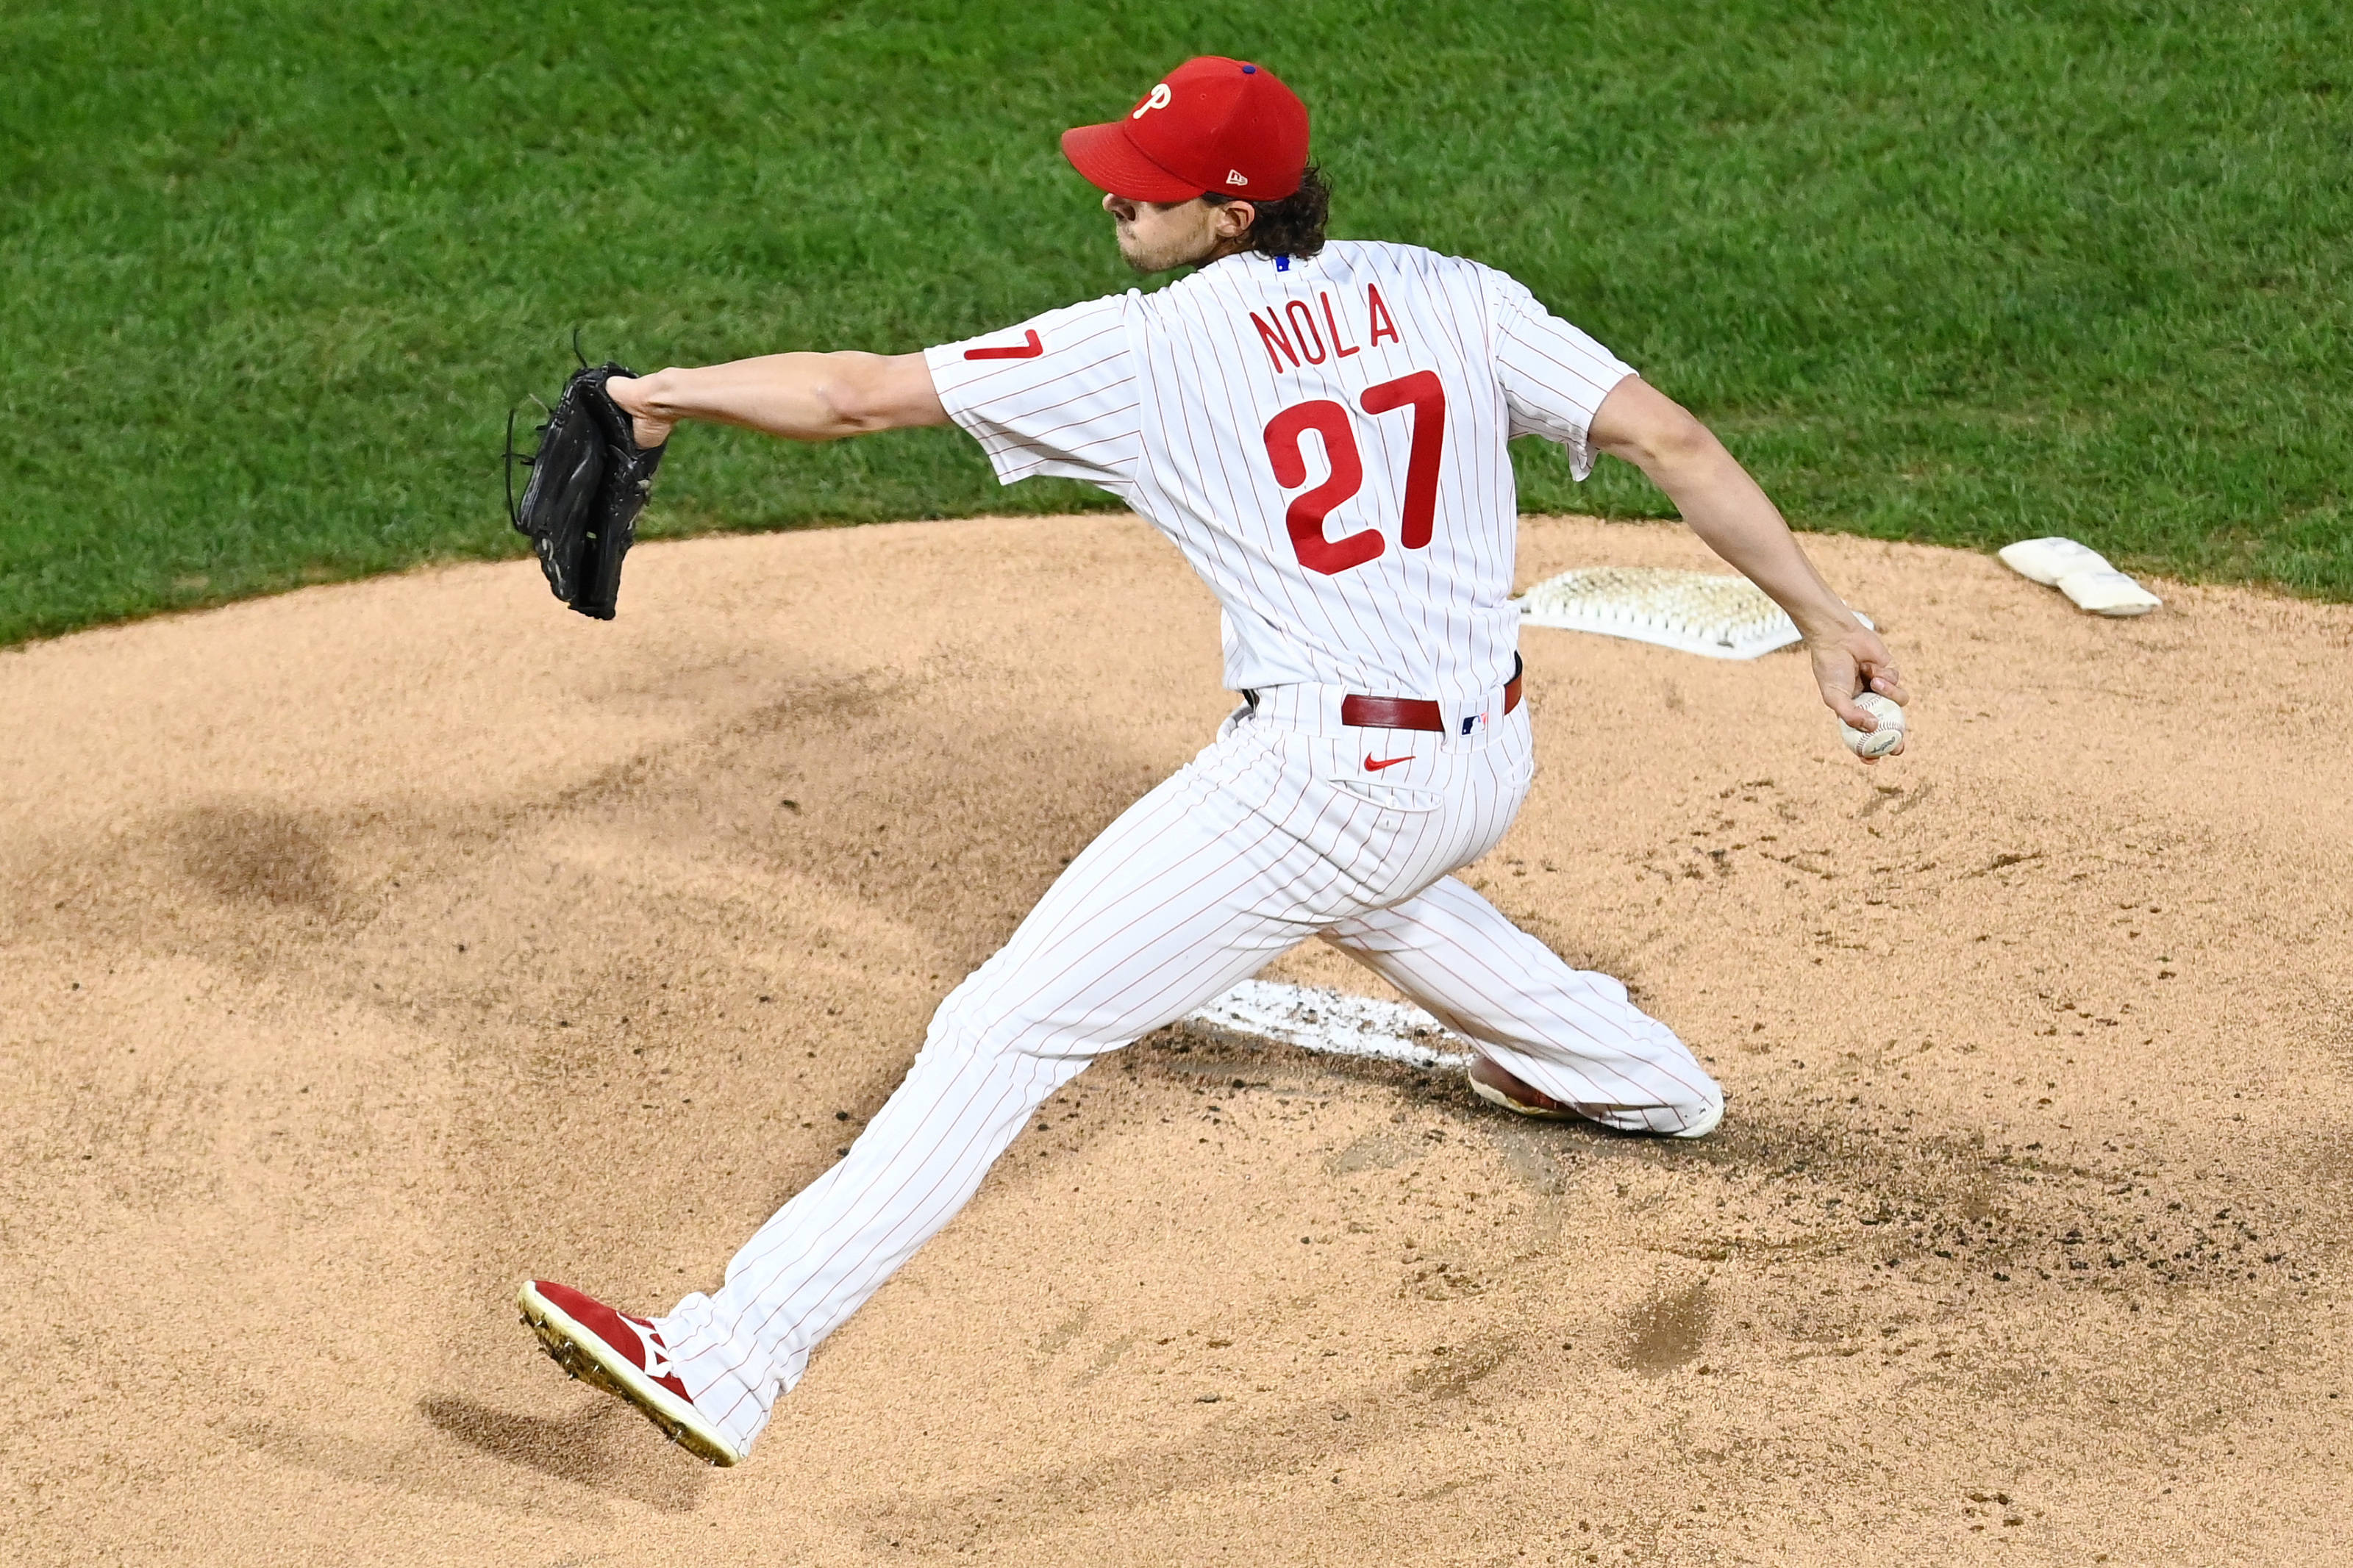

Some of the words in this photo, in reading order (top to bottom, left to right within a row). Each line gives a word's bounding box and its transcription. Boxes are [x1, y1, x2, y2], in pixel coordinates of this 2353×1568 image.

[1132, 82, 1171, 119] P
[964, 329, 1043, 360] 7
[1249, 282, 1399, 373] NOLA
[1263, 370, 1446, 576] 27
